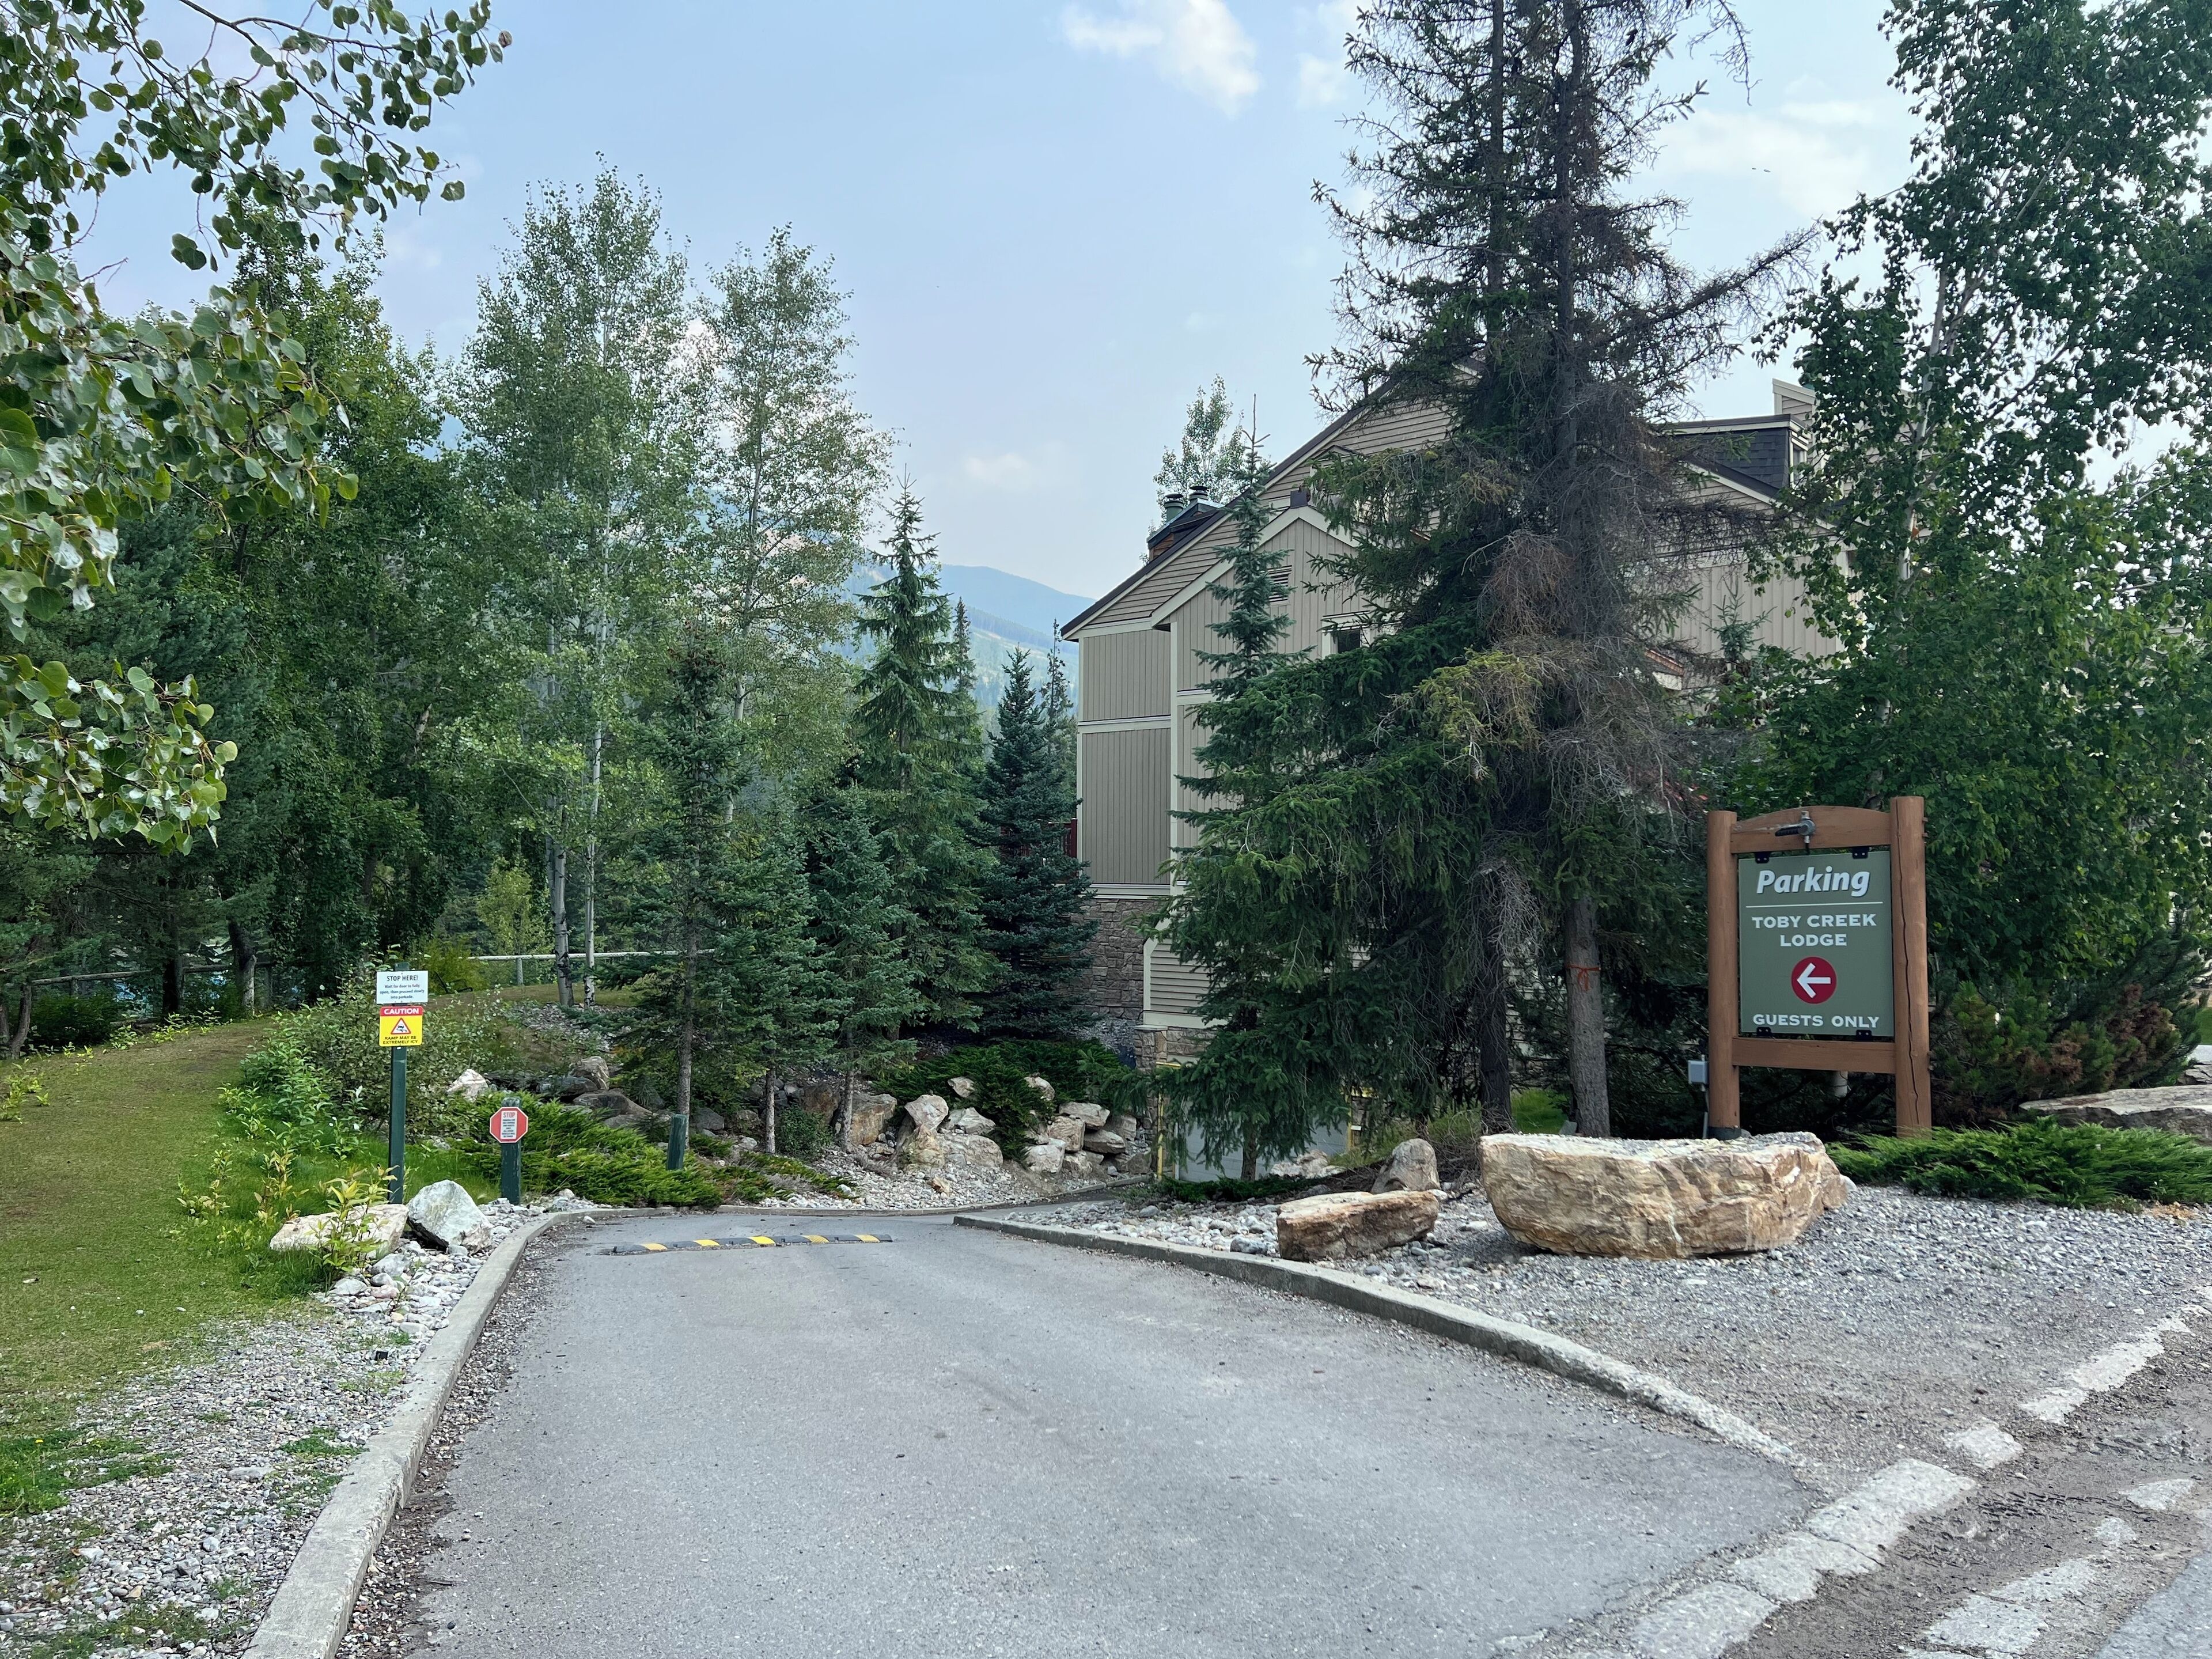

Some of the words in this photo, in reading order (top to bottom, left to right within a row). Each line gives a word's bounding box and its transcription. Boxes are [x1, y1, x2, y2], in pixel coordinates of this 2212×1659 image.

[1756, 866, 1870, 897] Parking
[1752, 916, 1801, 928] TOBY
[1807, 914, 1877, 927] CREEK
[1780, 934, 1847, 946] LODGE
[1753, 1014, 1823, 1026] GUESTS
[1831, 1016, 1879, 1028] ONLY
